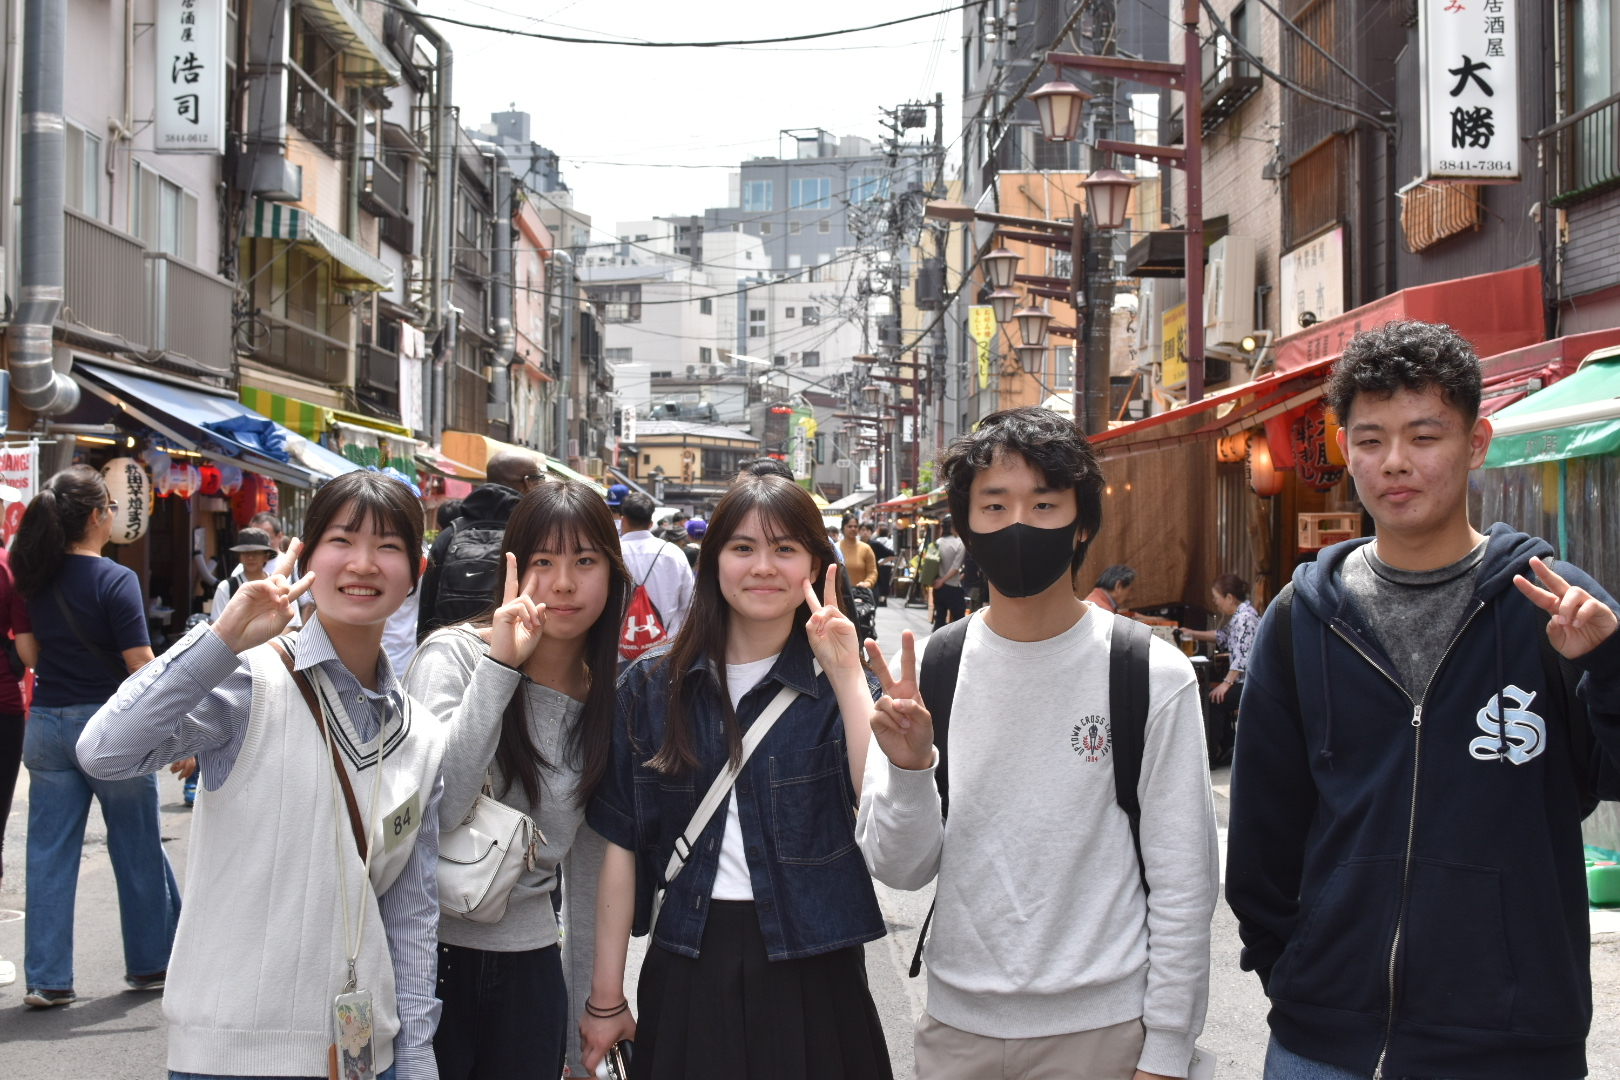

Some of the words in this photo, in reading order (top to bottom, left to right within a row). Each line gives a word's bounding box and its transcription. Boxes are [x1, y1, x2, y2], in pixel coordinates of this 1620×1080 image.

[171, 51, 205, 125] 浩司
[1448, 54, 1495, 149] 大勝
[164, 133, 209, 143] 3844-0612
[1439, 159, 1512, 171] 3841-7364
[978, 341, 990, 376] つくし
[1071, 724, 1085, 756] UPTOWN
[1080, 715, 1105, 726] CROSS
[1469, 685, 1546, 765] S
[394, 806, 411, 836] 84
